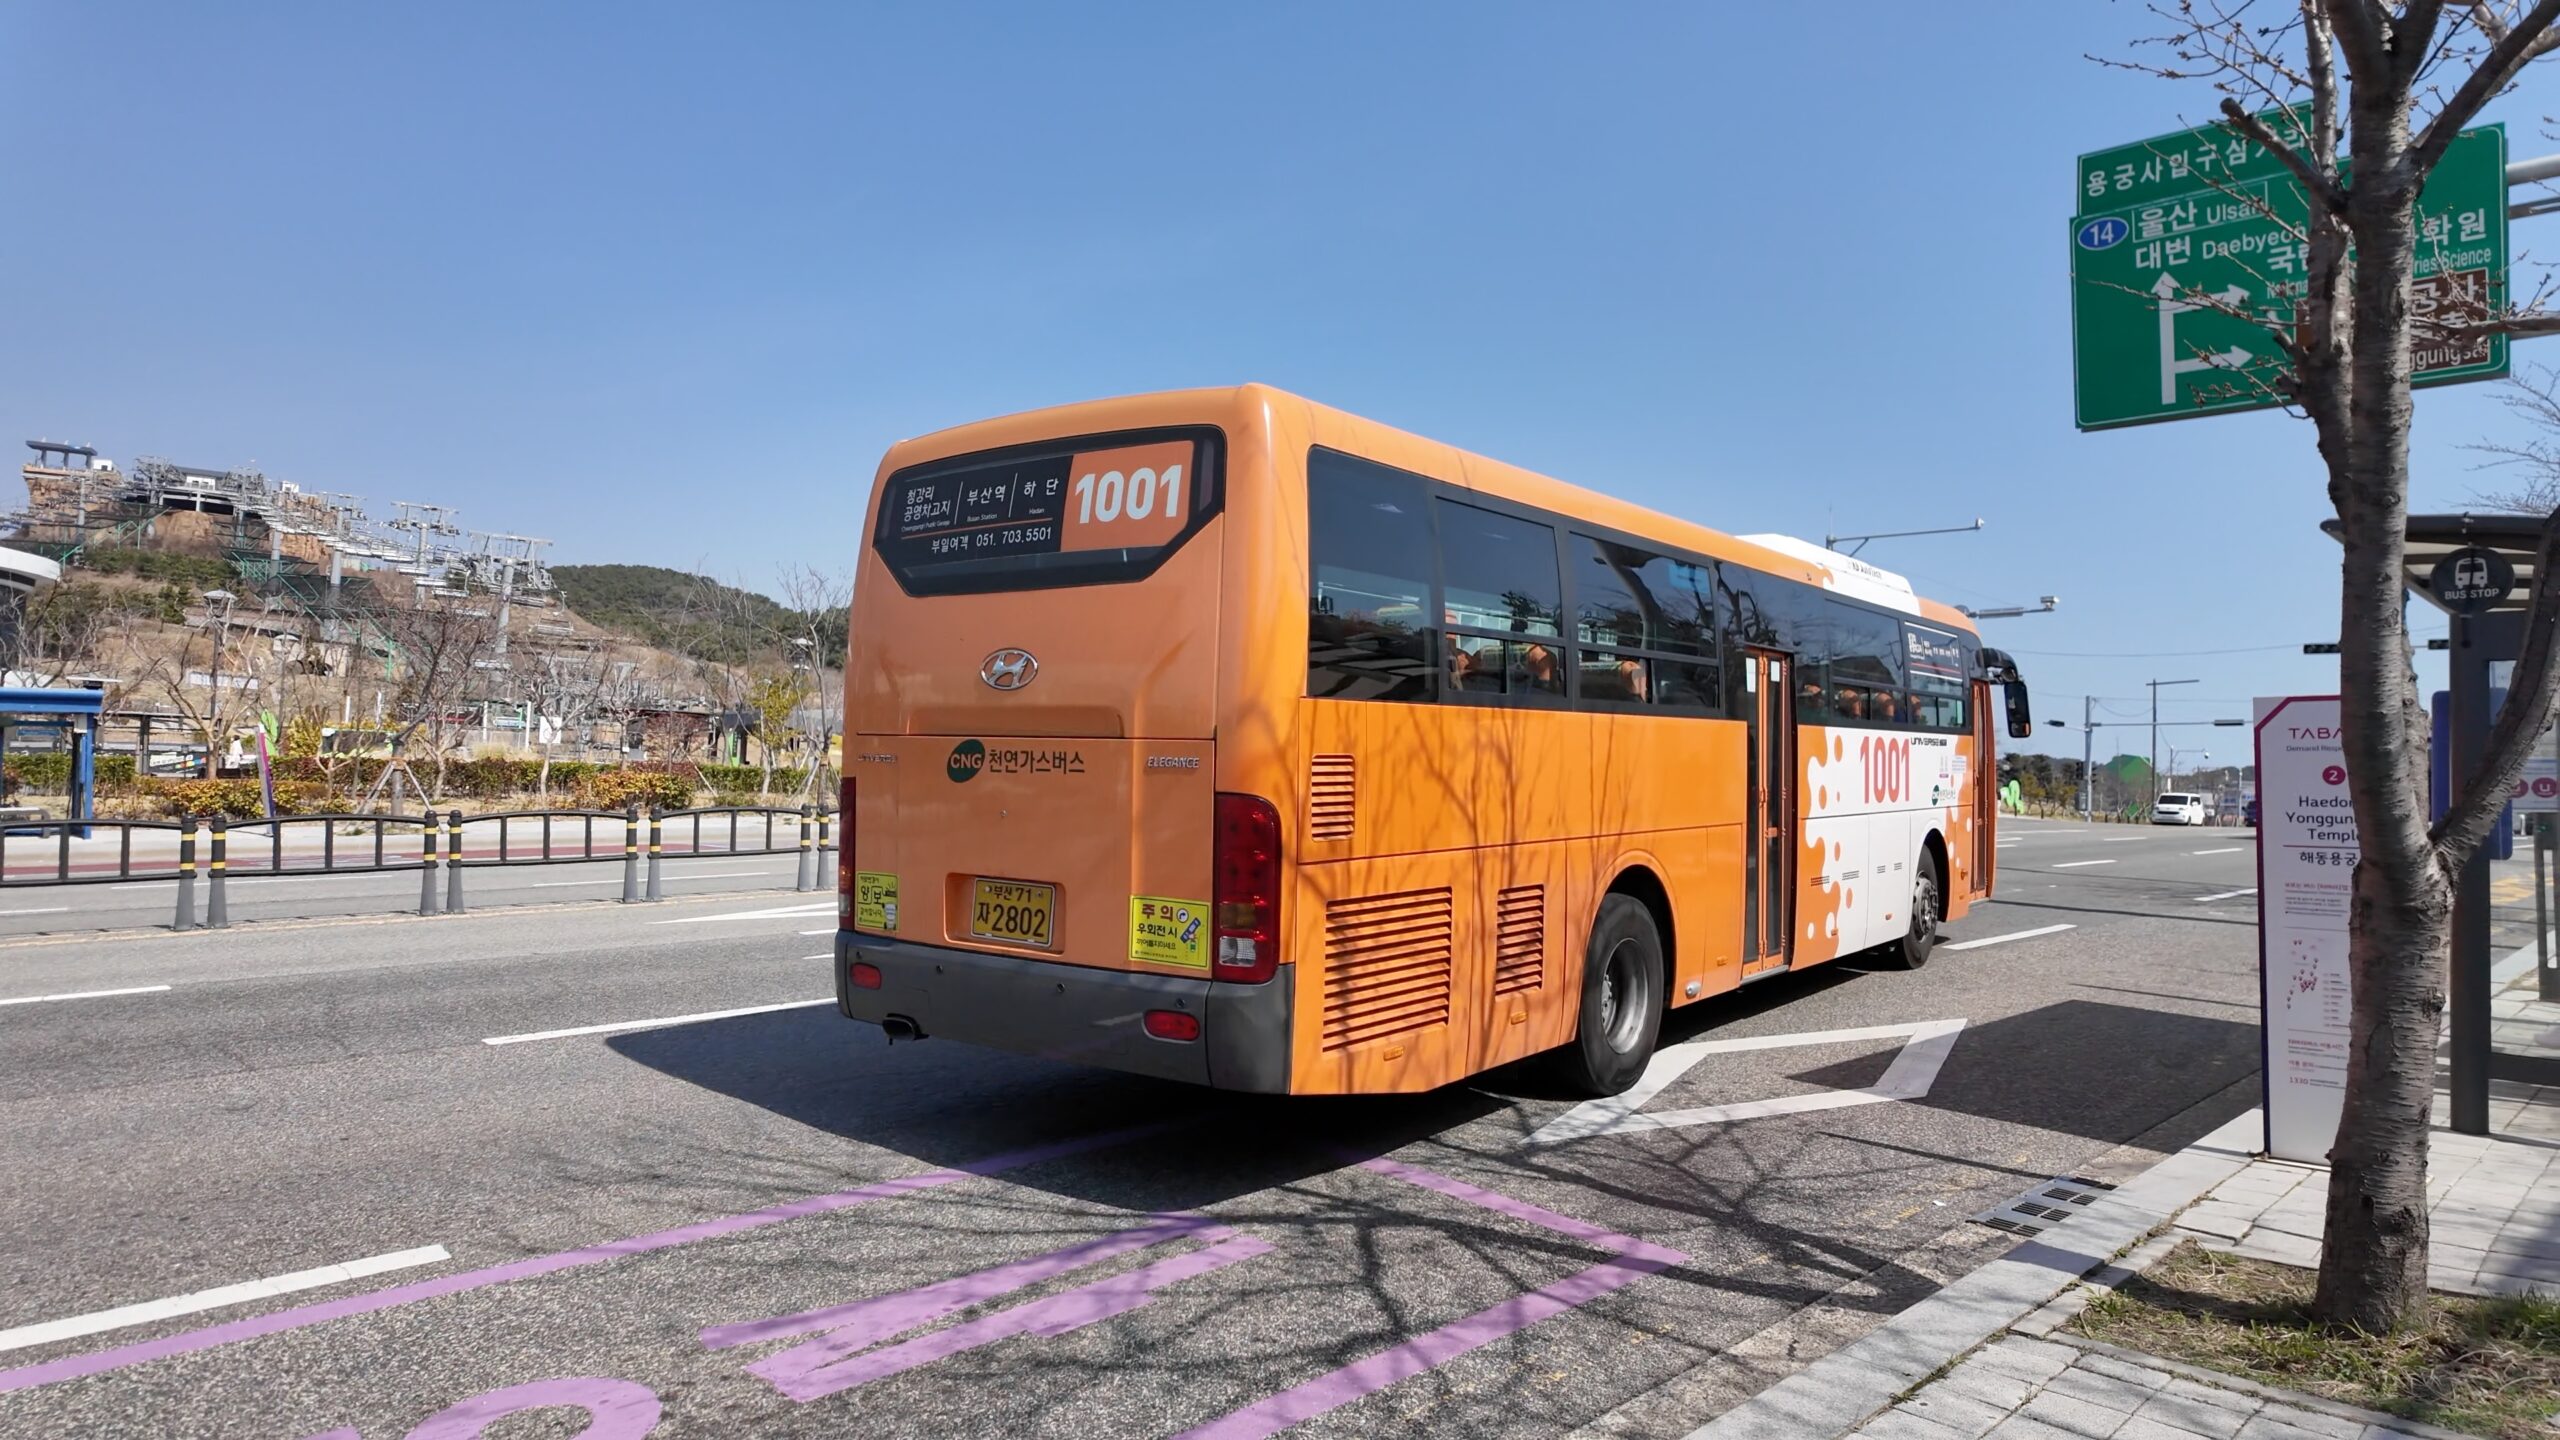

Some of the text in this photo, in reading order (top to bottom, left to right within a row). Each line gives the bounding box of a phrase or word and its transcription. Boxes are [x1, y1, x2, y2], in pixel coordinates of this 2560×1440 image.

[2086, 122, 2306, 197] 용궁사입구삼리
[2138, 200, 2198, 239] 울산
[2406, 208, 2488, 246] 학원
[2089, 221, 2115, 246] 14
[2135, 235, 2191, 269] 대변
[2413, 255, 2439, 275] ries
[966, 484, 1007, 507] 부산역
[1074, 464, 1183, 524] 1001
[903, 499, 951, 523] 공영차고지
[931, 535, 969, 554] 부일여객
[1002, 526, 1052, 545] 703.5501
[2444, 588, 2500, 600] BUS STOP
[950, 749, 1086, 774] CNG 천연가스버스
[1146, 755, 1200, 769] ELEGANCE
[1859, 735, 1910, 804] 1001
[2328, 769, 2338, 781] 2
[2285, 811, 2355, 828] Yonggun
[2307, 828, 2360, 843] Templ
[1136, 922, 1178, 939] 우회전 시
